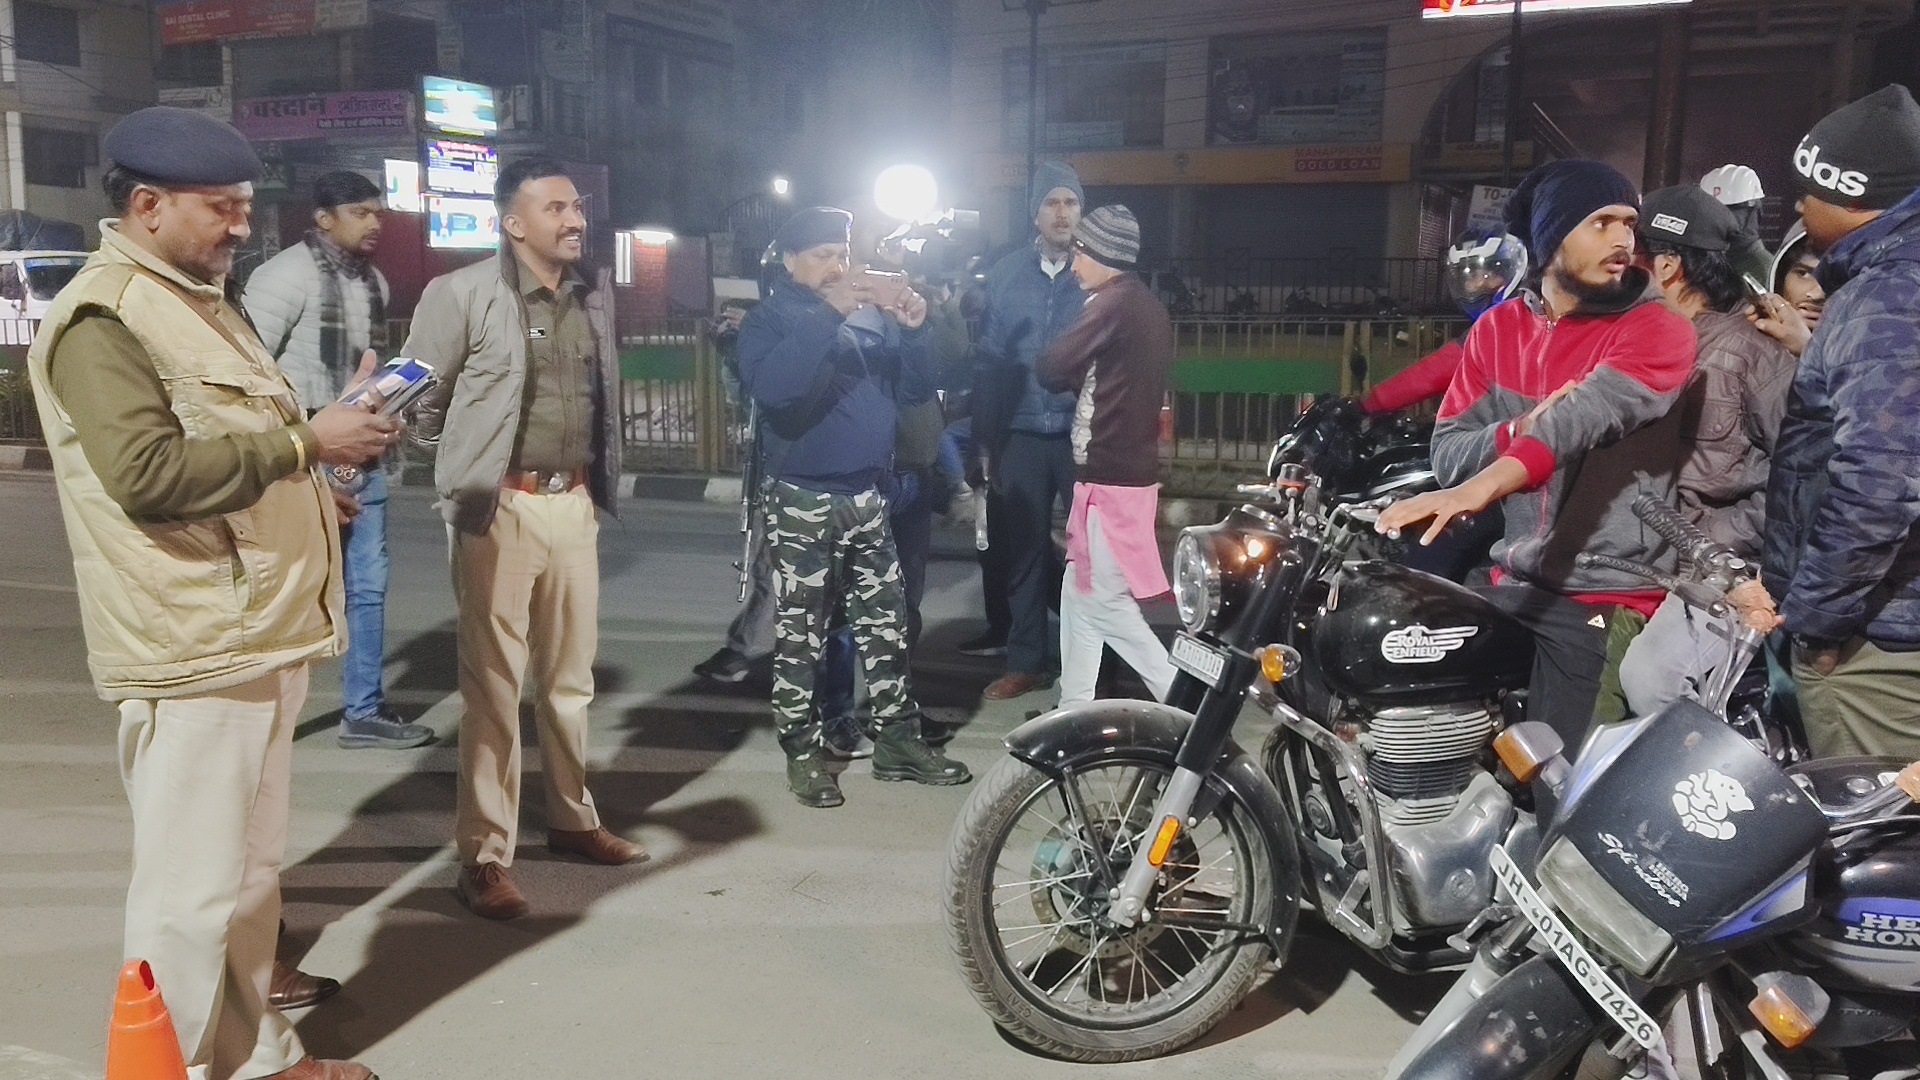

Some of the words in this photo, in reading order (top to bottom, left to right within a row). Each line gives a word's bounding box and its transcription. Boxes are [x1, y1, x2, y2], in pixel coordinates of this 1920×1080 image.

[177, 13, 205, 24] DENTAL
[206, 9, 230, 20] CLINIC
[1297, 160, 1336, 171] GOLD
[1340, 158, 1380, 169] LOAN
[1396, 635, 1435, 648] ROYAL
[1392, 646, 1441, 658] ENFIELD
[1648, 864, 1687, 901] HONDA
[1656, 862, 1690, 893] HERO
[1006, 992, 1032, 1018] CEAT
